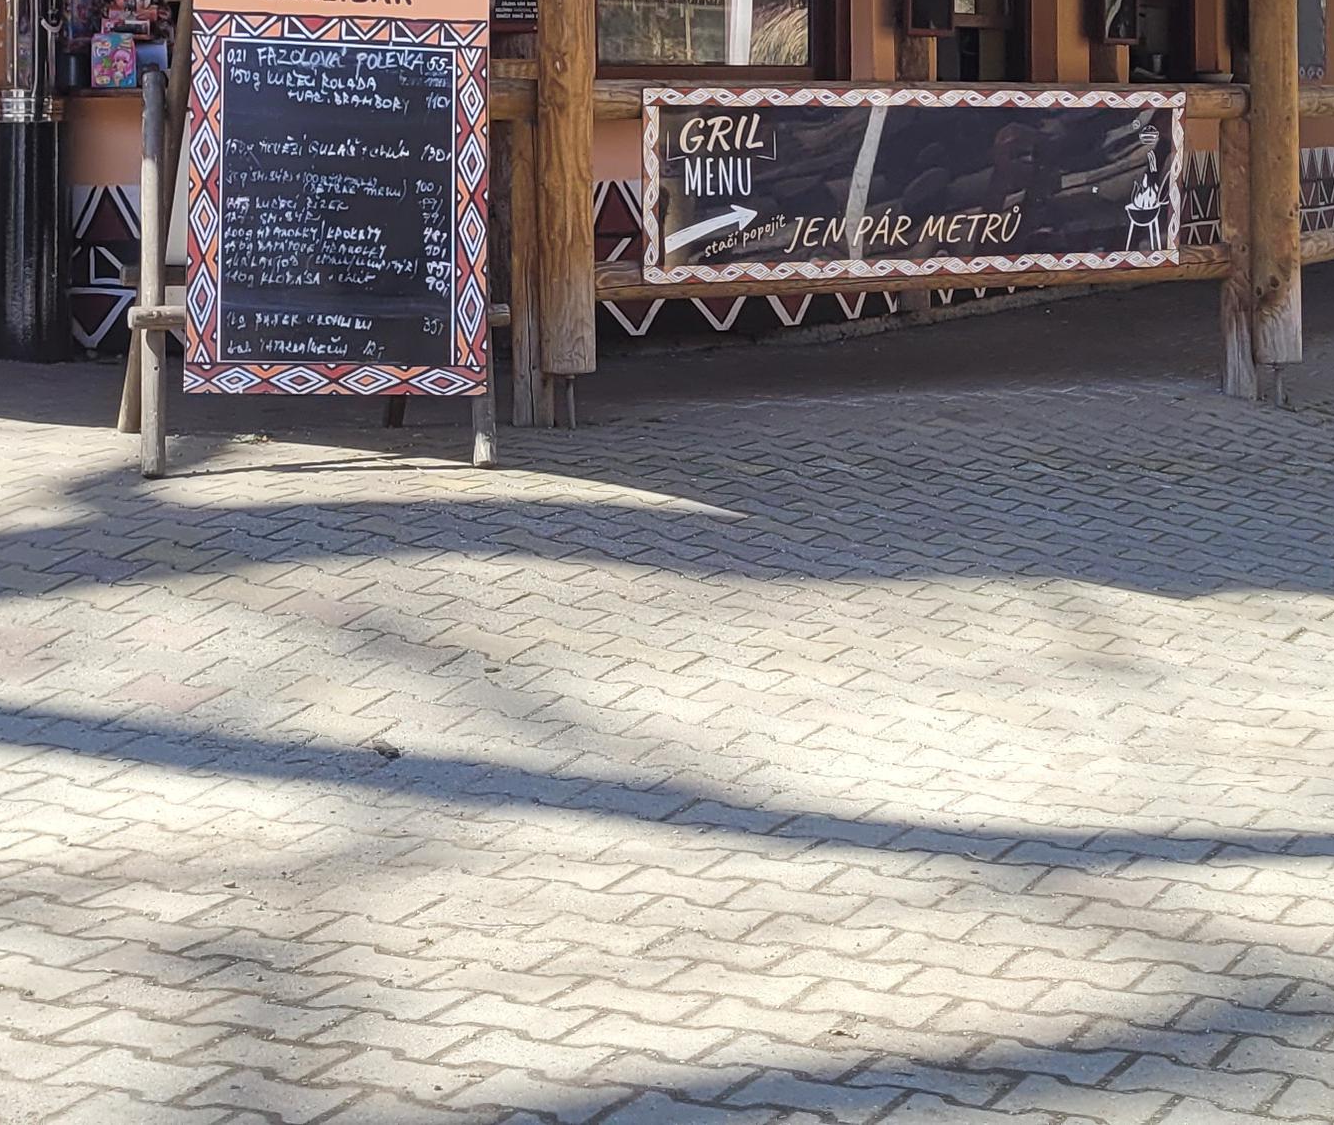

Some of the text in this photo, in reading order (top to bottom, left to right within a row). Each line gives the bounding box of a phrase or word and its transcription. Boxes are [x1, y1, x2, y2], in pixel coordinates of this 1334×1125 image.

[679, 113, 764, 154] GRIL
[684, 156, 751, 197] MENU
[704, 205, 1021, 258] stačí popojít JEN PÁR METRŮ
